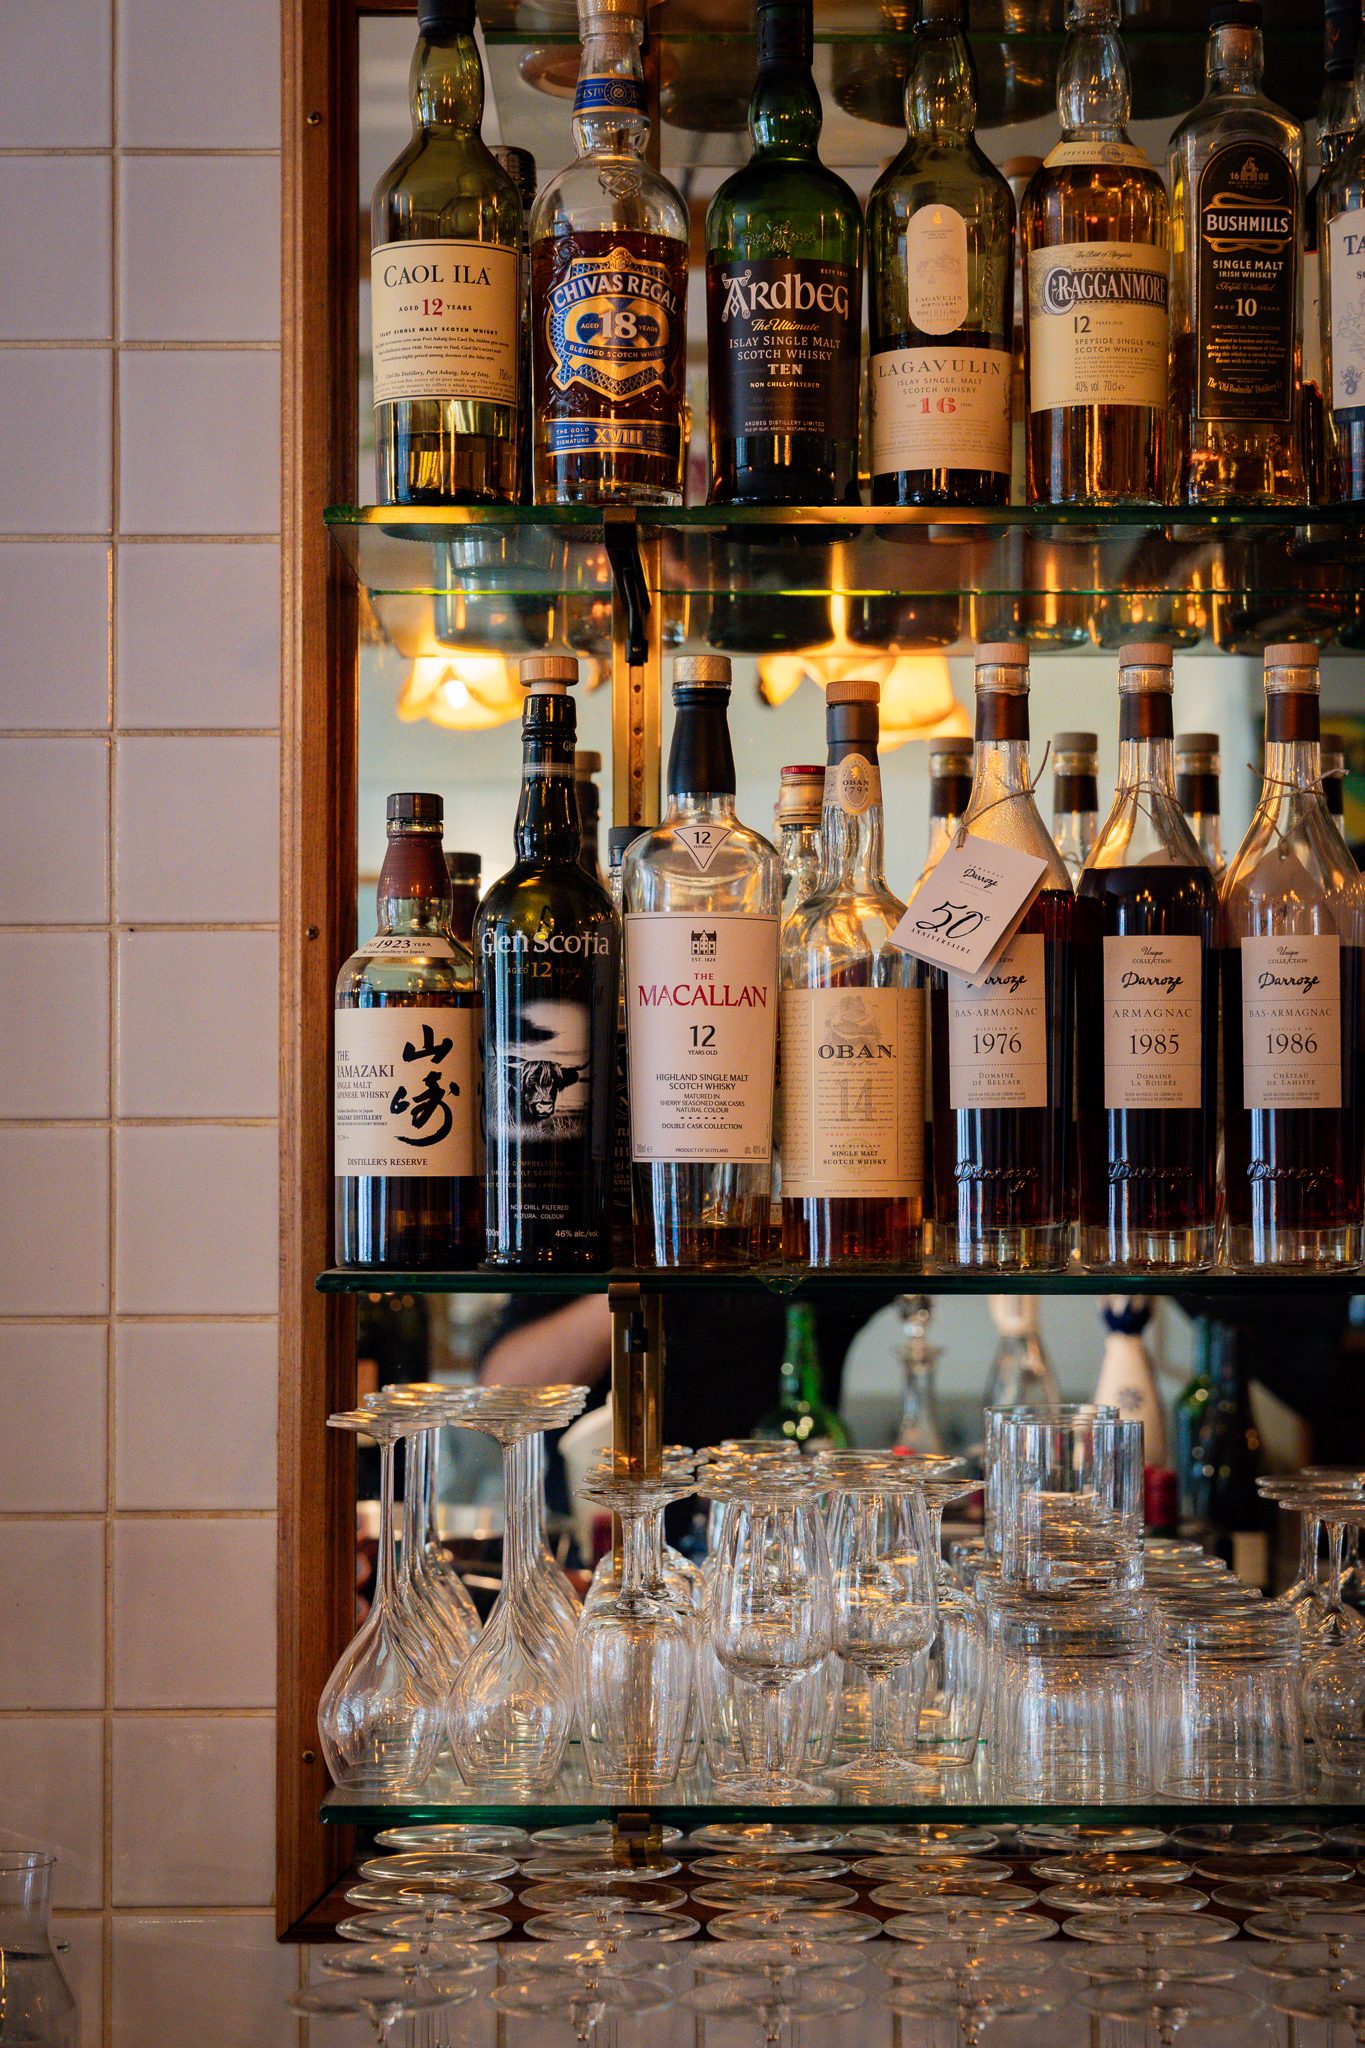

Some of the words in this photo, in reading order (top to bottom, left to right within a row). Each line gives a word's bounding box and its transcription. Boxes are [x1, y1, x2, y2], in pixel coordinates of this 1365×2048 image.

[1229, 172, 1239, 181] 16
[1206, 213, 1289, 233] BUSHMILLS
[1213, 259, 1252, 270] SINGLE
[1255, 261, 1284, 271] MALT
[384, 264, 444, 288] CAOL
[453, 265, 491, 286] ILA
[1242, 271, 1277, 279] WHISKEY
[554, 273, 623, 308] CHIVAS
[627, 275, 677, 315] REGAL
[721, 269, 848, 322] Ardbeg
[1041, 265, 1165, 315] CRAGGANMORE
[422, 298, 443, 316] 12
[1235, 298, 1257, 317] 10
[598, 310, 638, 340] 18
[751, 318, 771, 331] The
[770, 318, 820, 331] Ultimate
[1074, 315, 1091, 334] 12
[472, 328, 499, 336] WHISKY
[729, 336, 760, 349] ISLAY
[763, 335, 808, 346] SINGLE
[812, 336, 841, 349] MALT
[1075, 338, 1114, 346] SPEYSIDE
[1117, 338, 1144, 346] SINGLE
[569, 344, 605, 357] BLENDED
[607, 350, 639, 358] SCOTCH
[737, 350, 781, 361] SCOTCH
[786, 350, 833, 361] WHISKY
[1075, 346, 1110, 354] SCOTCH
[1113, 346, 1143, 354] WHISKY
[426, 368, 439, 376] Port
[768, 364, 803, 375] TEN
[878, 359, 1001, 378] LAGAVULIN
[767, 381, 820, 389] CHILL-FILTERED
[897, 378, 920, 386] ISLAY
[924, 377, 956, 385] SINGLE
[961, 377, 983, 385] MALT
[1075, 381, 1088, 392] 40%
[1091, 381, 1099, 392] vol
[903, 387, 938, 395] SCOTCH
[943, 386, 977, 394] WHISKY
[920, 396, 957, 414] 16
[556, 438, 590, 446] SIGNATURE
[593, 428, 643, 445] XVIII
[693, 831, 711, 844] 12
[376, 939, 412, 949] 1923
[481, 928, 528, 957] Glen
[532, 930, 610, 957] Scotia
[507, 966, 529, 974] AGED
[530, 961, 552, 978] 12
[967, 974, 1028, 993] arroze
[1121, 971, 1184, 994] Darroze
[1258, 971, 1321, 994] Darroze
[638, 984, 767, 1008] MACALLAN
[955, 1007, 1038, 1017] BAS-ARMAGNAC
[1112, 1008, 1193, 1018] ARMAGNAC
[1249, 1008, 1332, 1018] BAS-ARMAGNAC
[689, 1024, 716, 1048] 12
[972, 1032, 1022, 1055] 1976
[1129, 1034, 1179, 1055] 1985
[1266, 1033, 1318, 1055] 1986
[337, 1050, 350, 1062] THE
[656, 1074, 698, 1082] HIGHLAND
[700, 1074, 728, 1082] SINGLE
[729, 1074, 749, 1082] MALT
[353, 1081, 373, 1089] MALT
[705, 1083, 736, 1091] WHISKY
[359, 1090, 391, 1099] WHISKY
[347, 1158, 388, 1166] DISTILLER'S
[389, 1158, 428, 1166] RESERVE
[823, 1158, 854, 1166] SCOTCH
[856, 1158, 887, 1166] WHISKY
[555, 1230, 573, 1238] 46%
